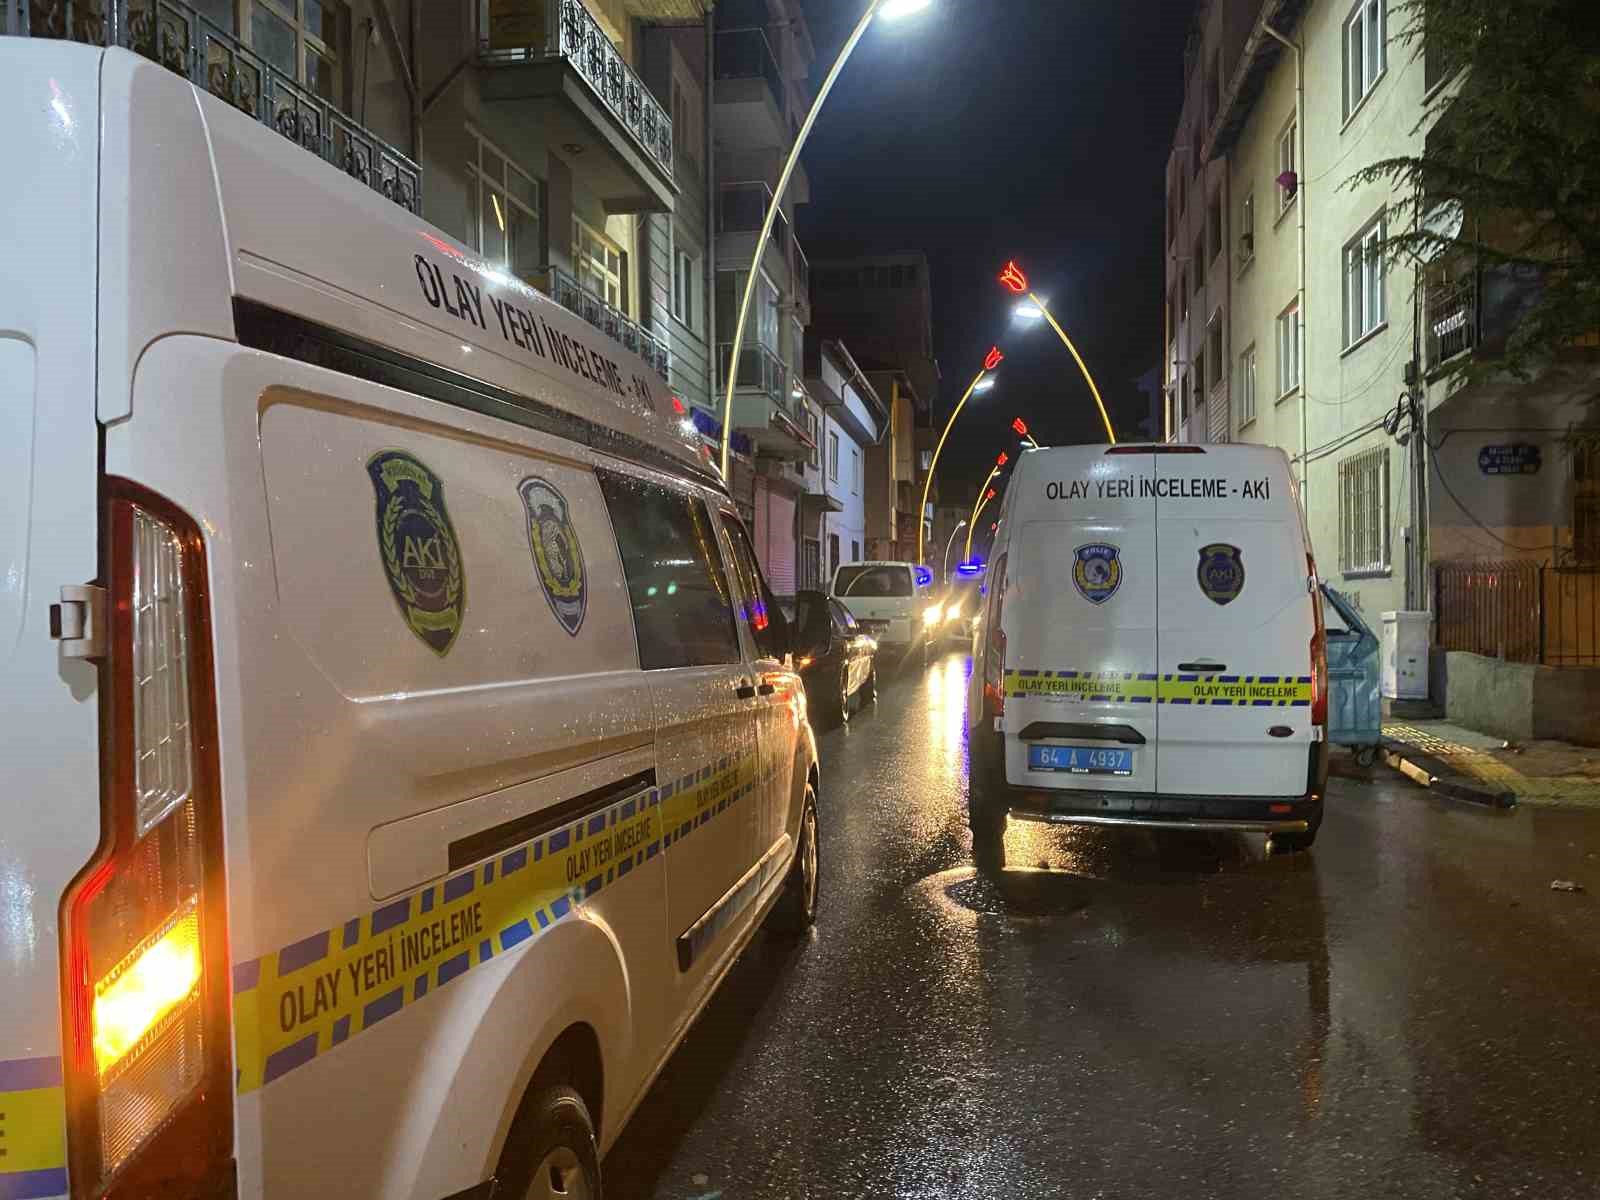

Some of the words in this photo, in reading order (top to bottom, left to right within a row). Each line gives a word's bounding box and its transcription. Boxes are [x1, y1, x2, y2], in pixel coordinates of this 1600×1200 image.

[414, 254, 487, 330] OLAY
[1046, 481, 1090, 500] OLAY
[1095, 475, 1135, 498] YERİ
[1139, 475, 1228, 498] İNCELEME
[1242, 476, 1270, 500] AKİ
[1018, 679, 1045, 690] OLAY
[1193, 685, 1220, 696] OLAY
[1040, 749, 1059, 764] 64
[1069, 750, 1078, 765] A
[1089, 751, 1125, 768] 4937
[566, 846, 590, 882] OLAY
[279, 968, 341, 1033] OLAY
[348, 939, 395, 996] YERİ
[401, 901, 483, 972] İNCELEME
